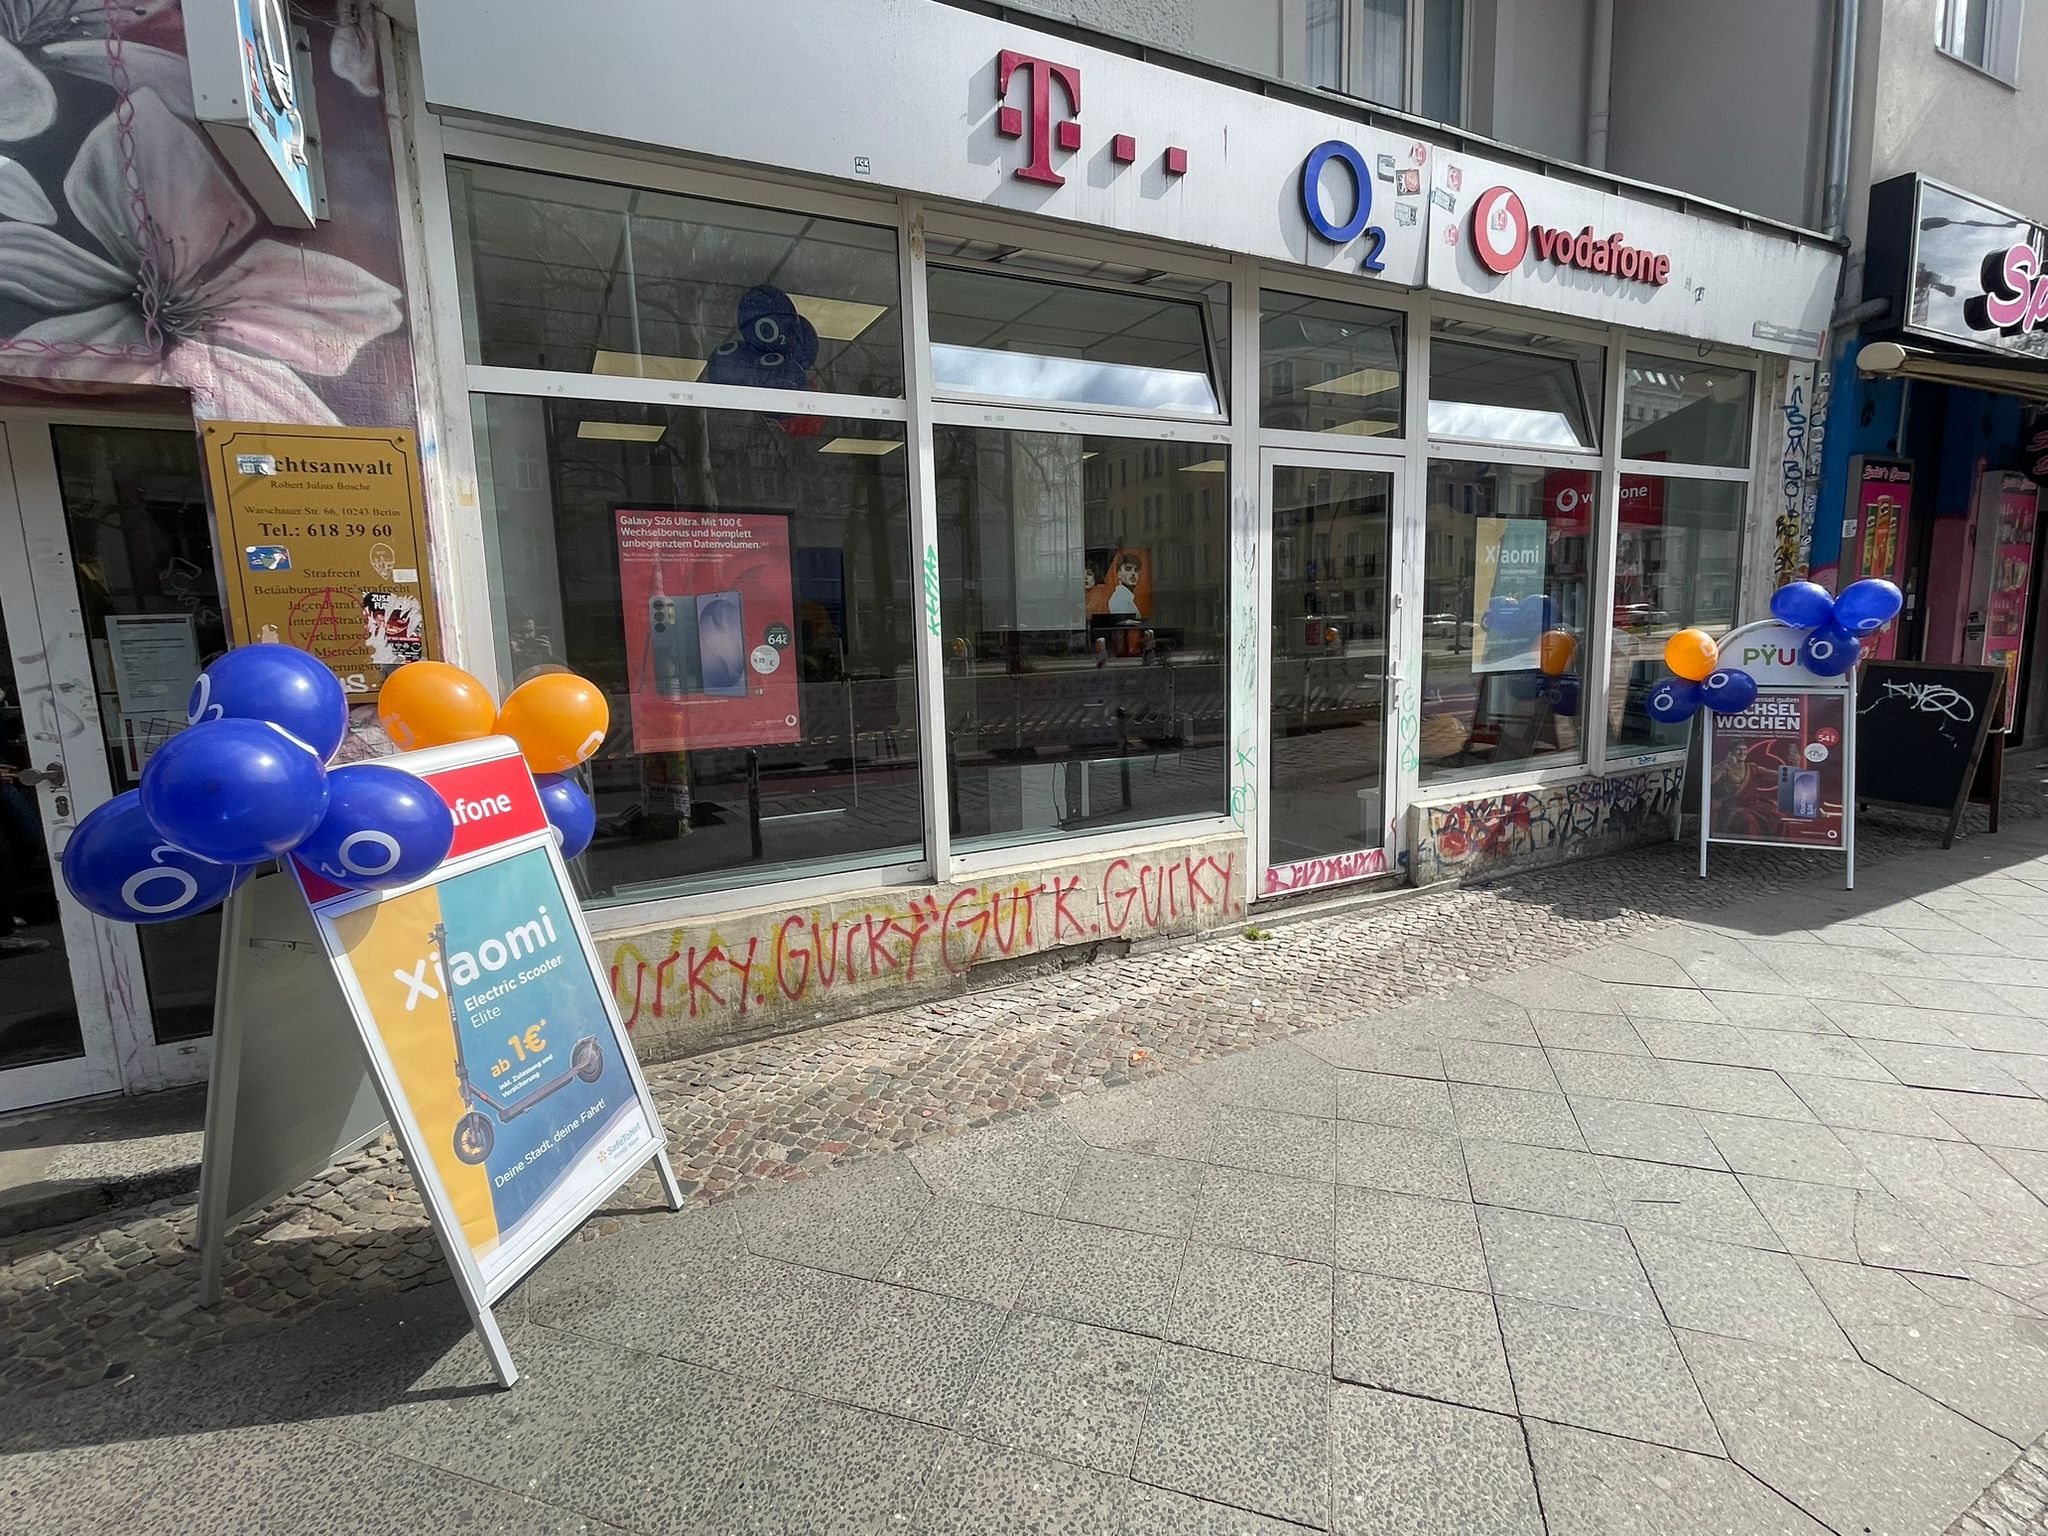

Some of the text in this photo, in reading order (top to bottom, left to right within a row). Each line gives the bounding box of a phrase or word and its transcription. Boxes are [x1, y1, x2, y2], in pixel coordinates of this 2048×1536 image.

[1533, 225, 1671, 287] vodafone
[1986, 243, 2048, 334] Sp
[275, 457, 394, 475] chtsanwalt
[270, 480, 304, 489] Robert
[305, 481, 335, 490] Julius
[243, 505, 302, 516] Warschauer
[304, 507, 320, 516] Str.
[342, 507, 370, 516] 10243
[373, 508, 401, 517] Berlin
[258, 522, 393, 537] Tel.: 618 39 60
[620, 515, 653, 527] Galaxy
[654, 516, 673, 526] S26
[674, 516, 700, 526] Ultra.
[701, 517, 717, 527] Mit
[718, 518, 735, 527] 100
[621, 527, 752, 540] Wechselbonus und komplett
[622, 539, 761, 550] unbegrenztem Datenvolumen.
[303, 568, 361, 579] Strafrecht
[1743, 643, 1801, 666] PŸU
[1740, 703, 1801, 716] CHSEL
[1716, 715, 1800, 730] WOCHEN
[449, 794, 512, 826] fone
[464, 953, 562, 1012] Electric Scooter
[470, 1004, 502, 1029] Elite
[491, 1058, 511, 1078] ab
[512, 1060, 542, 1081] Zulassung
[541, 1053, 554, 1065] und
[501, 1072, 541, 1098] Versicherung
[494, 1098, 606, 1188] Deine Stadt, deine Fahrt!
